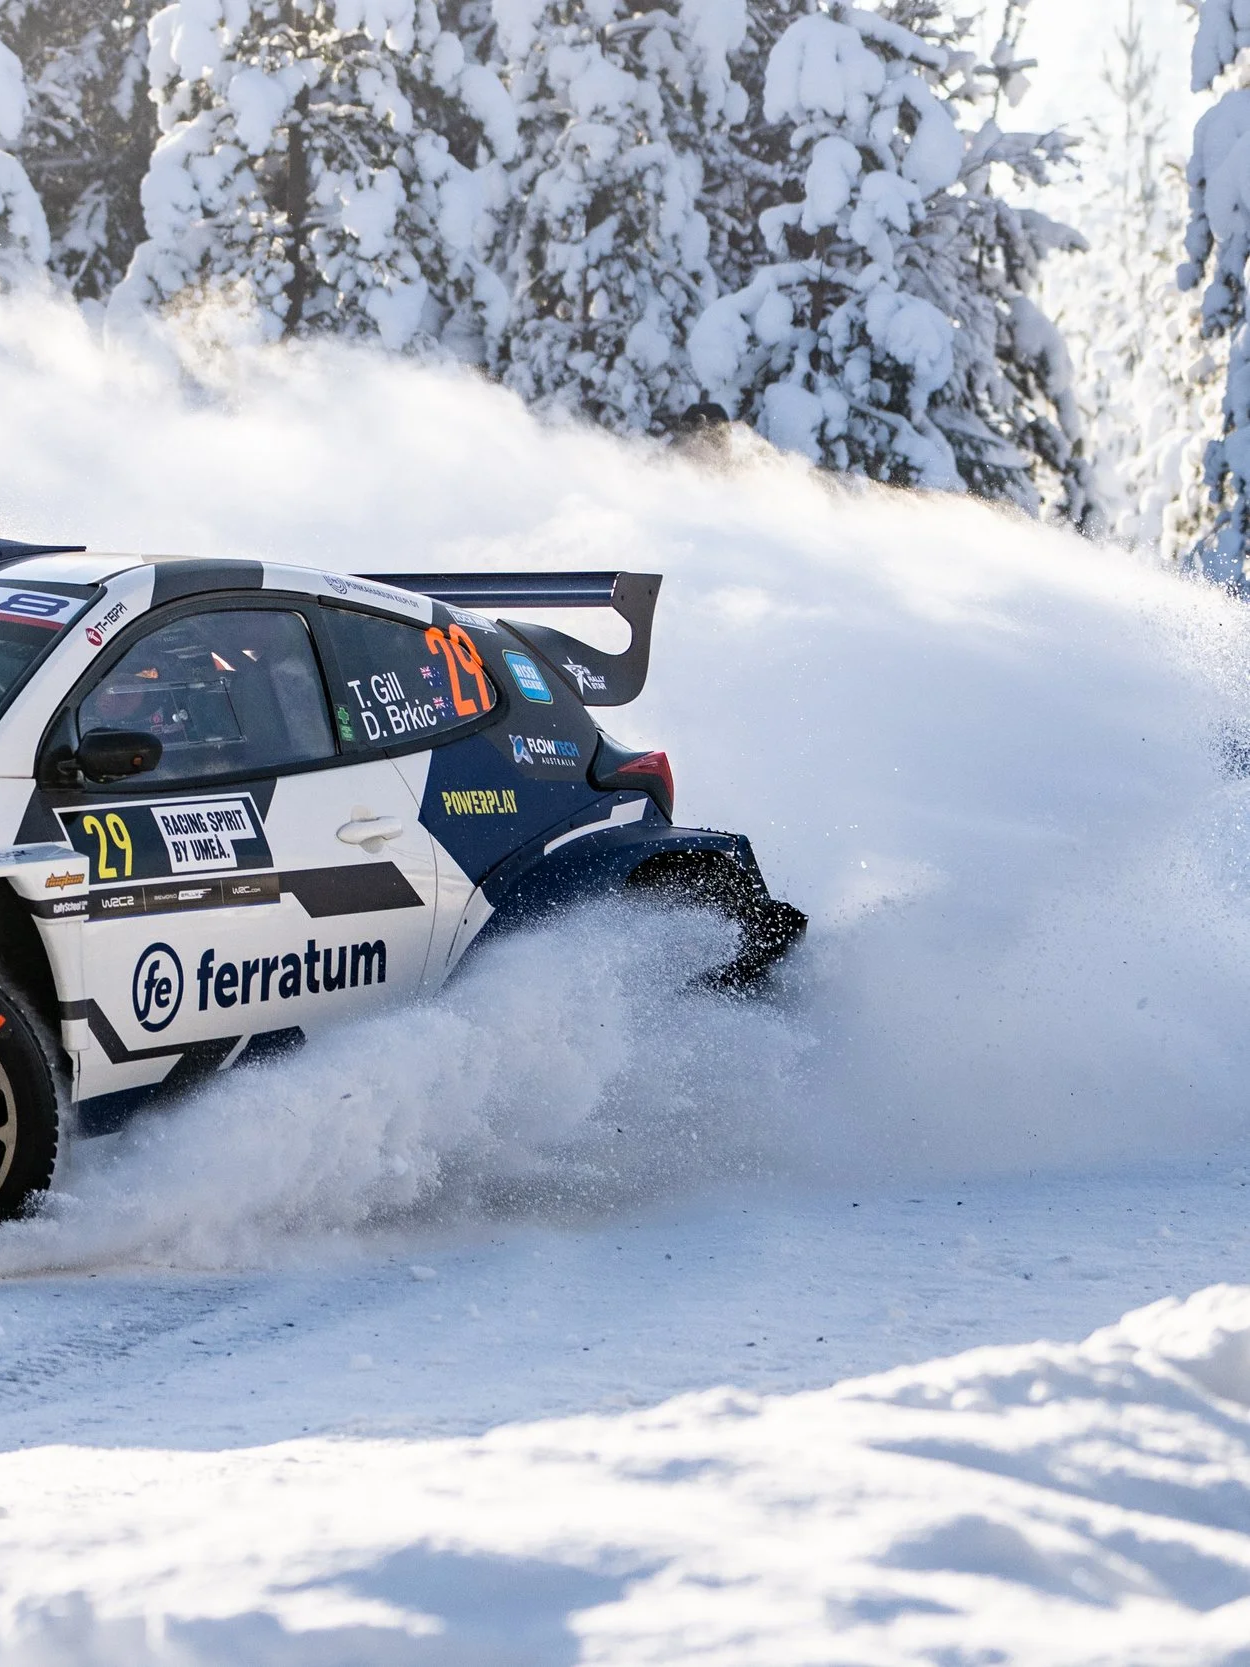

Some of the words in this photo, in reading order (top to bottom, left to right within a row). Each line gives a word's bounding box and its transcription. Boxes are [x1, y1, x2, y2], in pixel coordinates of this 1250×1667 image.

[425, 623, 491, 717] 29
[347, 680, 372, 709] T.
[370, 671, 406, 704] Gill
[361, 711, 388, 741] D.
[385, 699, 438, 735] Brkic
[526, 737, 580, 758] FLOWTECH
[541, 757, 577, 767] AUSTRALIA
[441, 788, 518, 816] POWERPLAY
[160, 809, 206, 836] RACING
[208, 806, 247, 832] SPIRIT
[82, 813, 134, 880] 29
[171, 839, 190, 863] BY
[101, 895, 135, 909] WRC2
[196, 938, 387, 1011] ferratum
